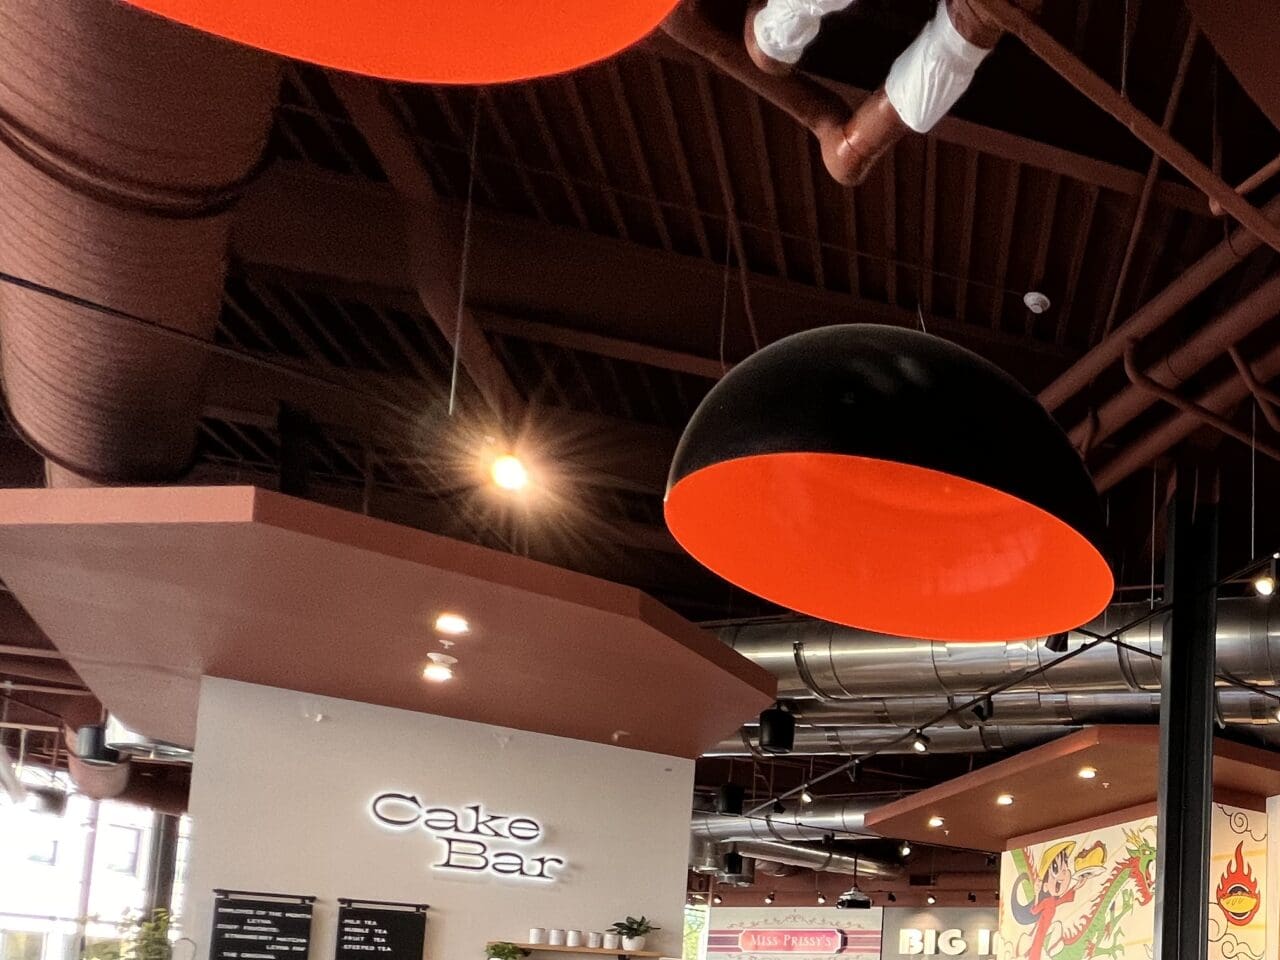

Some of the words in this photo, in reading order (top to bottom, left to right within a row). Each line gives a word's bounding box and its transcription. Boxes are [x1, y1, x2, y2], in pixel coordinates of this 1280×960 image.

[372, 793, 540, 840] Cake
[431, 836, 564, 880] Bar
[751, 934, 778, 947] MISS
[897, 929, 968, 956] BIG
